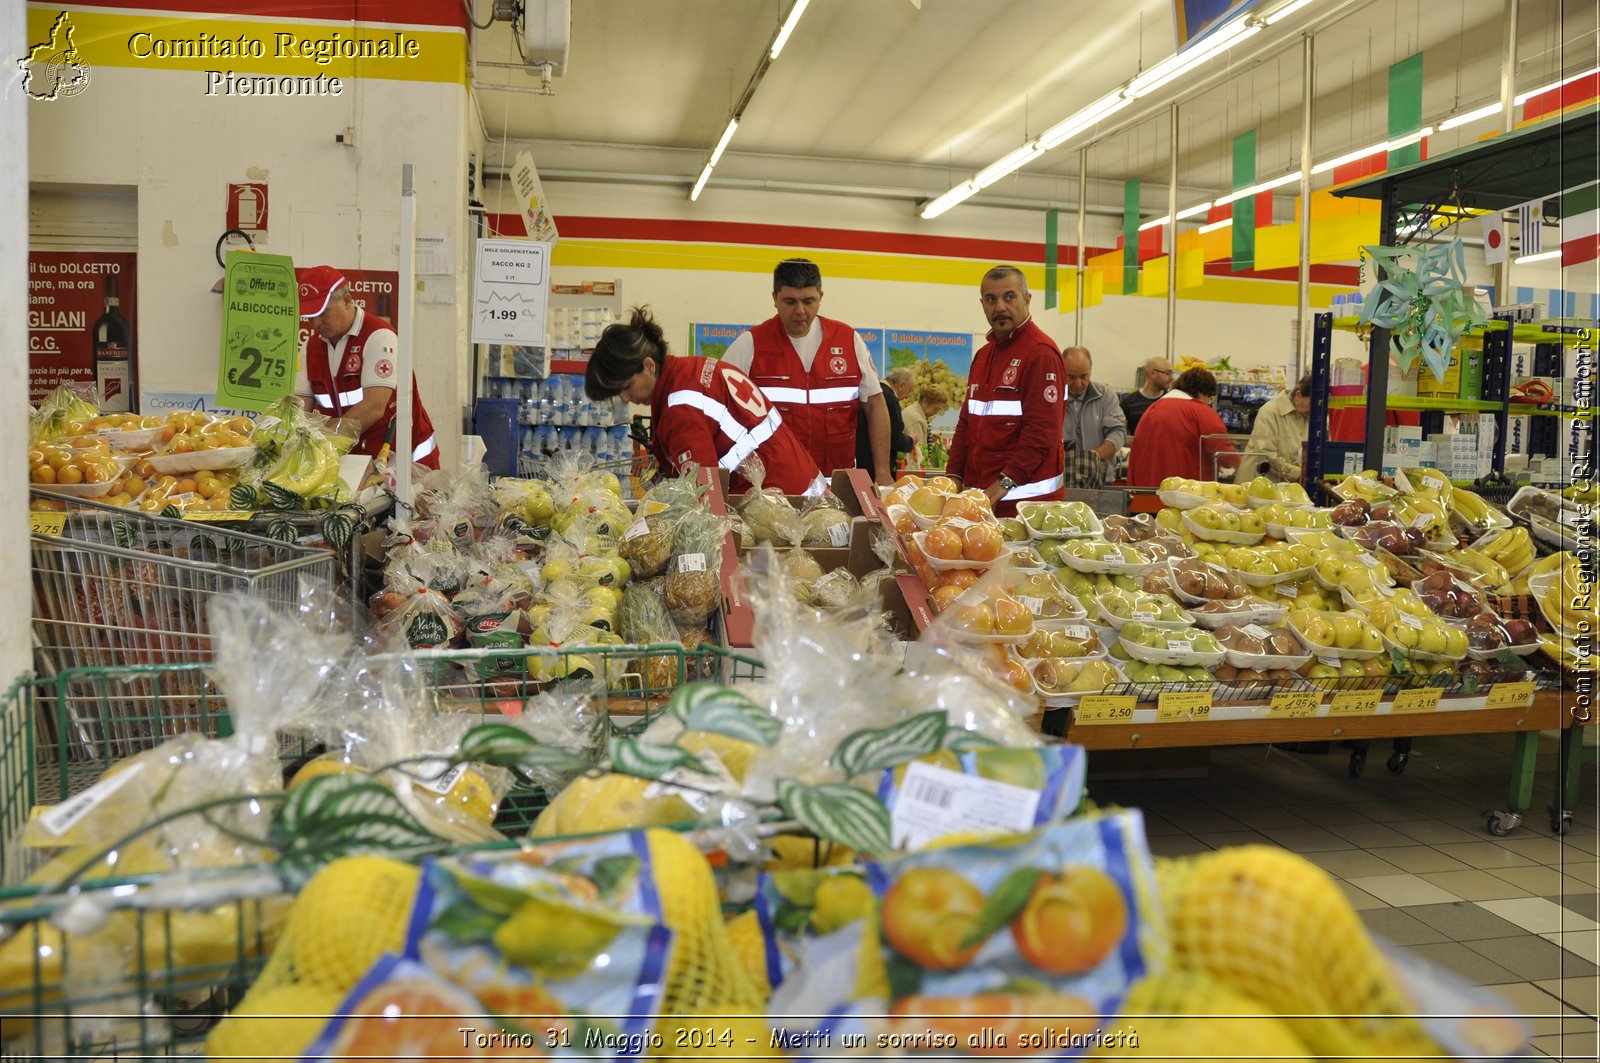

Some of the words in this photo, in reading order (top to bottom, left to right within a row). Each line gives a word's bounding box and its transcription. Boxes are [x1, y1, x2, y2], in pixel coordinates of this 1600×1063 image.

[30, 263, 36, 273] il
[39, 264, 57, 273] tuo
[60, 263, 121, 274] DOLCETTO
[58, 281, 75, 289] ma
[77, 281, 95, 289] ora
[250, 277, 275, 291] Offerta
[349, 281, 392, 293] LCETTO
[230, 301, 294, 316] ALBICOCCHE
[489, 309, 517, 320] 1.99
[899, 334, 923, 343] dolce
[49, 367, 56, 375] in
[58, 367, 70, 377] più
[71, 368, 83, 377] per
[227, 367, 238, 385] €
[263, 357, 286, 377] 75
[34, 377, 48, 385] che
[49, 377, 58, 385] mi
[150, 398, 184, 409] Colora
[1511, 693, 1528, 702] 1,99
[1355, 702, 1375, 710] 2,15
[1418, 699, 1437, 708] 2,15
[1109, 708, 1131, 718] 2,50
[1190, 706, 1210, 716] 1,99
